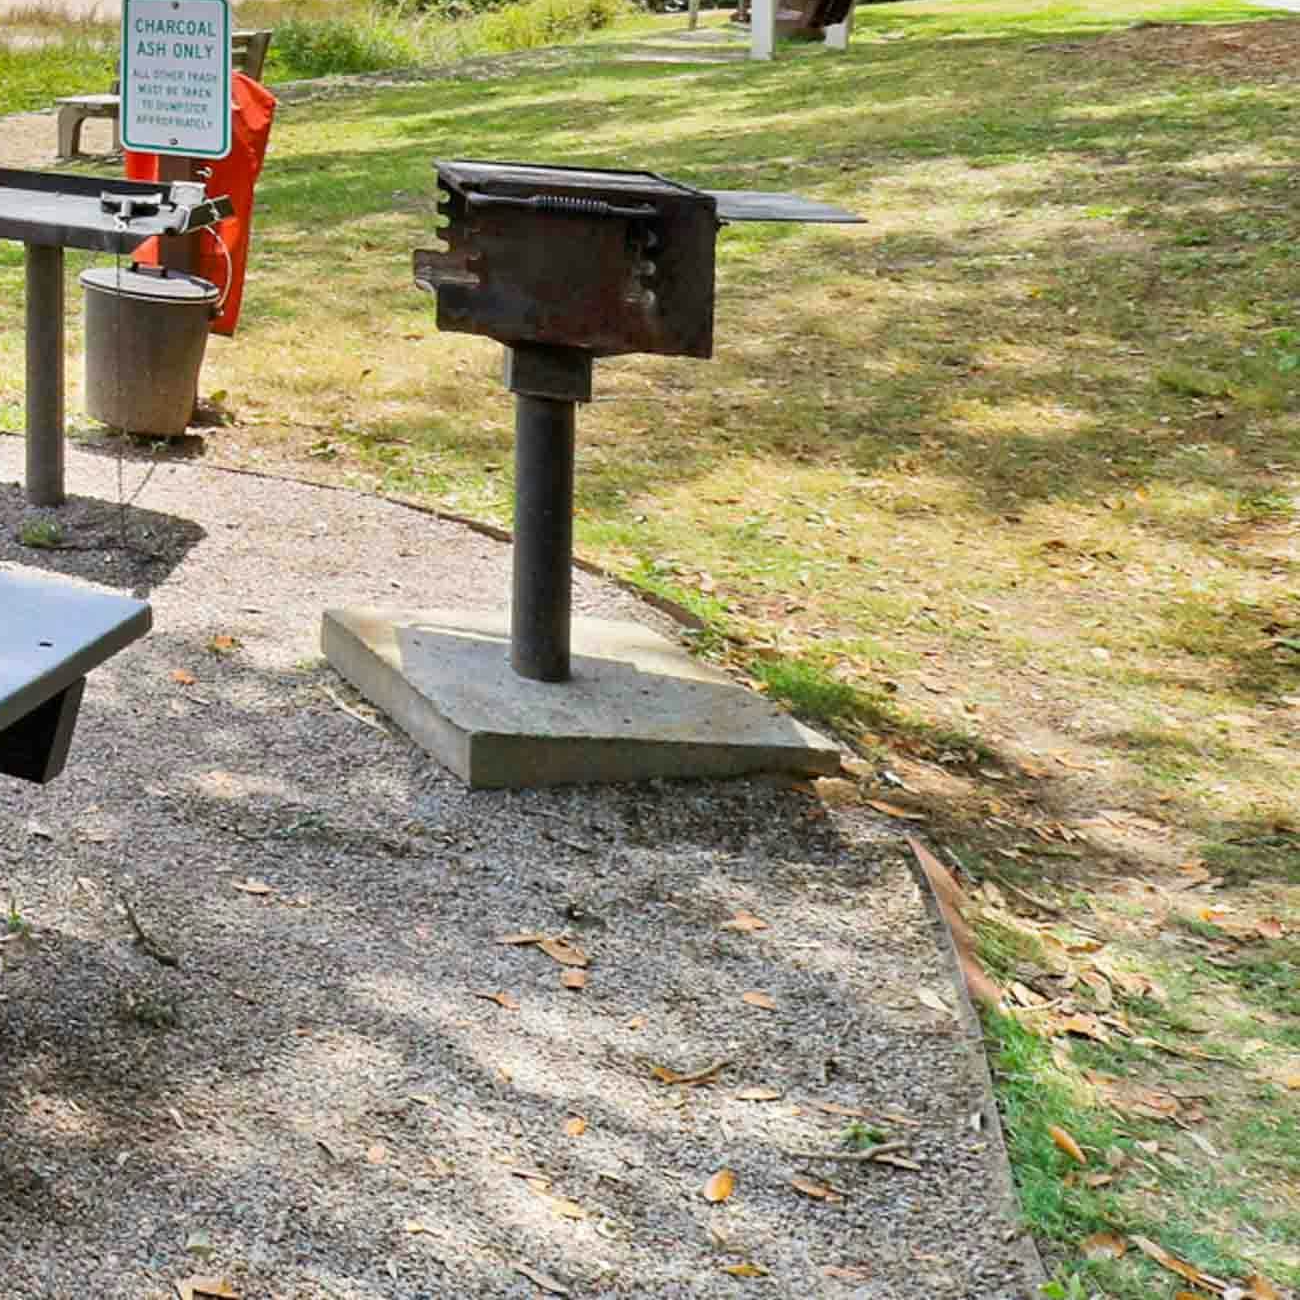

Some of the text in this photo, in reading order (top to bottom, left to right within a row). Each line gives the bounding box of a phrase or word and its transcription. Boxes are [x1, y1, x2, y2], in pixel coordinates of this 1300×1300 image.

[135, 17, 216, 36] CHARCOAL
[136, 41, 214, 59] ASH ONLY
